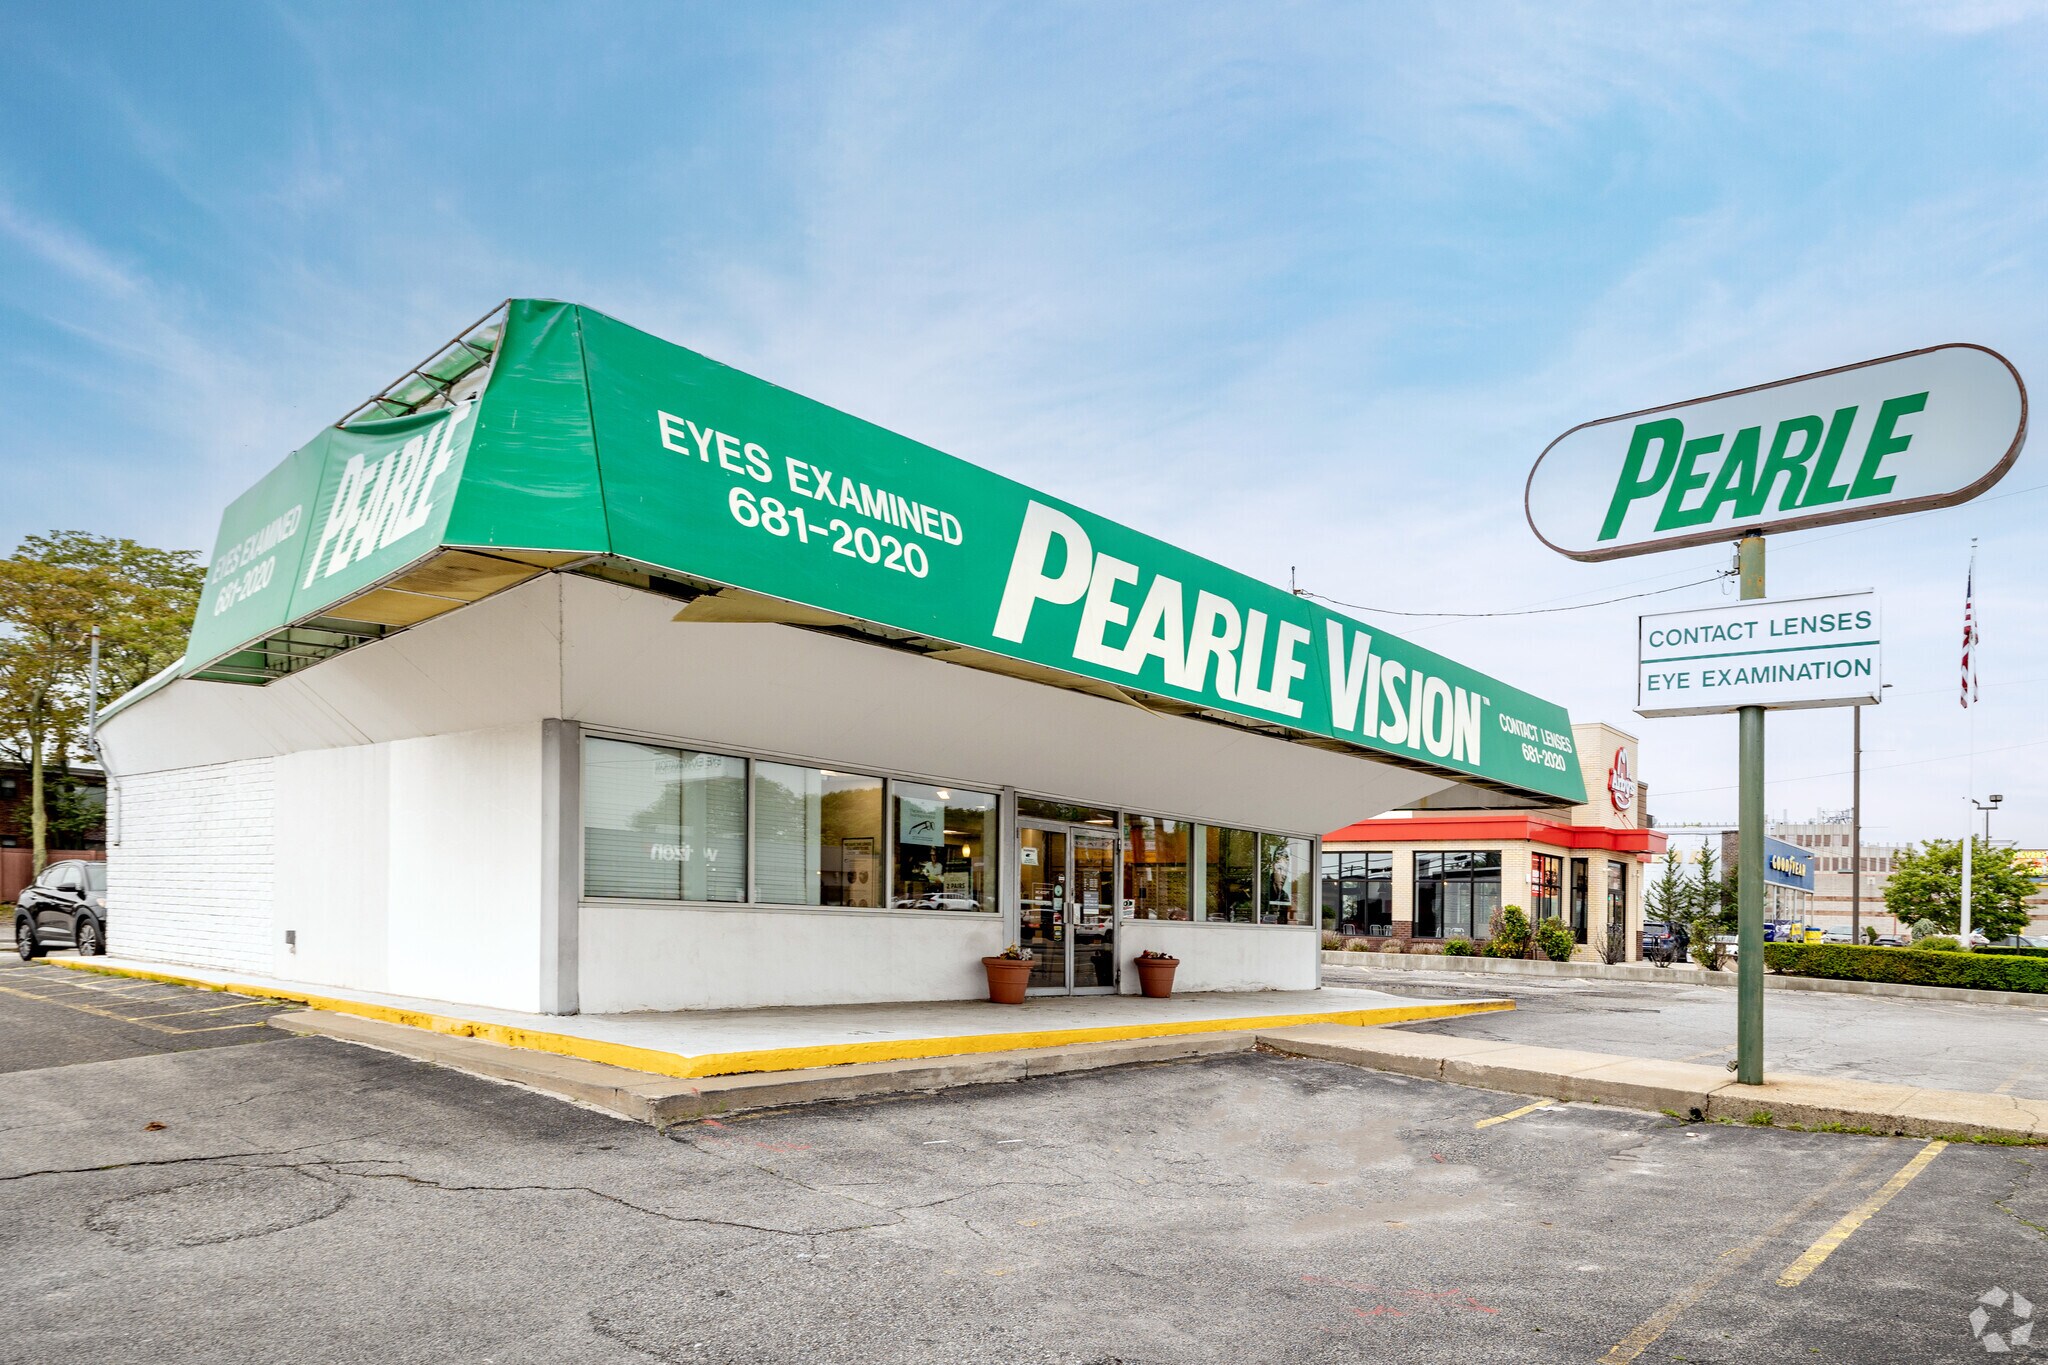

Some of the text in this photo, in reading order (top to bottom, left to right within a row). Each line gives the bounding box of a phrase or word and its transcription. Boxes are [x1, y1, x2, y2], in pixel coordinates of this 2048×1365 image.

[303, 402, 471, 590] PEARLE
[657, 409, 963, 546] EYES EXAMINED
[1597, 391, 1930, 542] PEARLE
[211, 504, 302, 585] EYES EXAMINED
[728, 487, 929, 579] 681-2020
[214, 555, 276, 617] 681-2020
[992, 499, 1311, 719] PEARLE
[1326, 618, 1480, 767] VISION
[1649, 610, 1872, 648] CONTACT LENSES
[1647, 658, 1871, 691] EYE EXAMINATION
[1499, 713, 1573, 754] CONTACT LENSES
[1521, 742, 1566, 772] 681-2020
[1771, 854, 1807, 878] GOODYEAR
